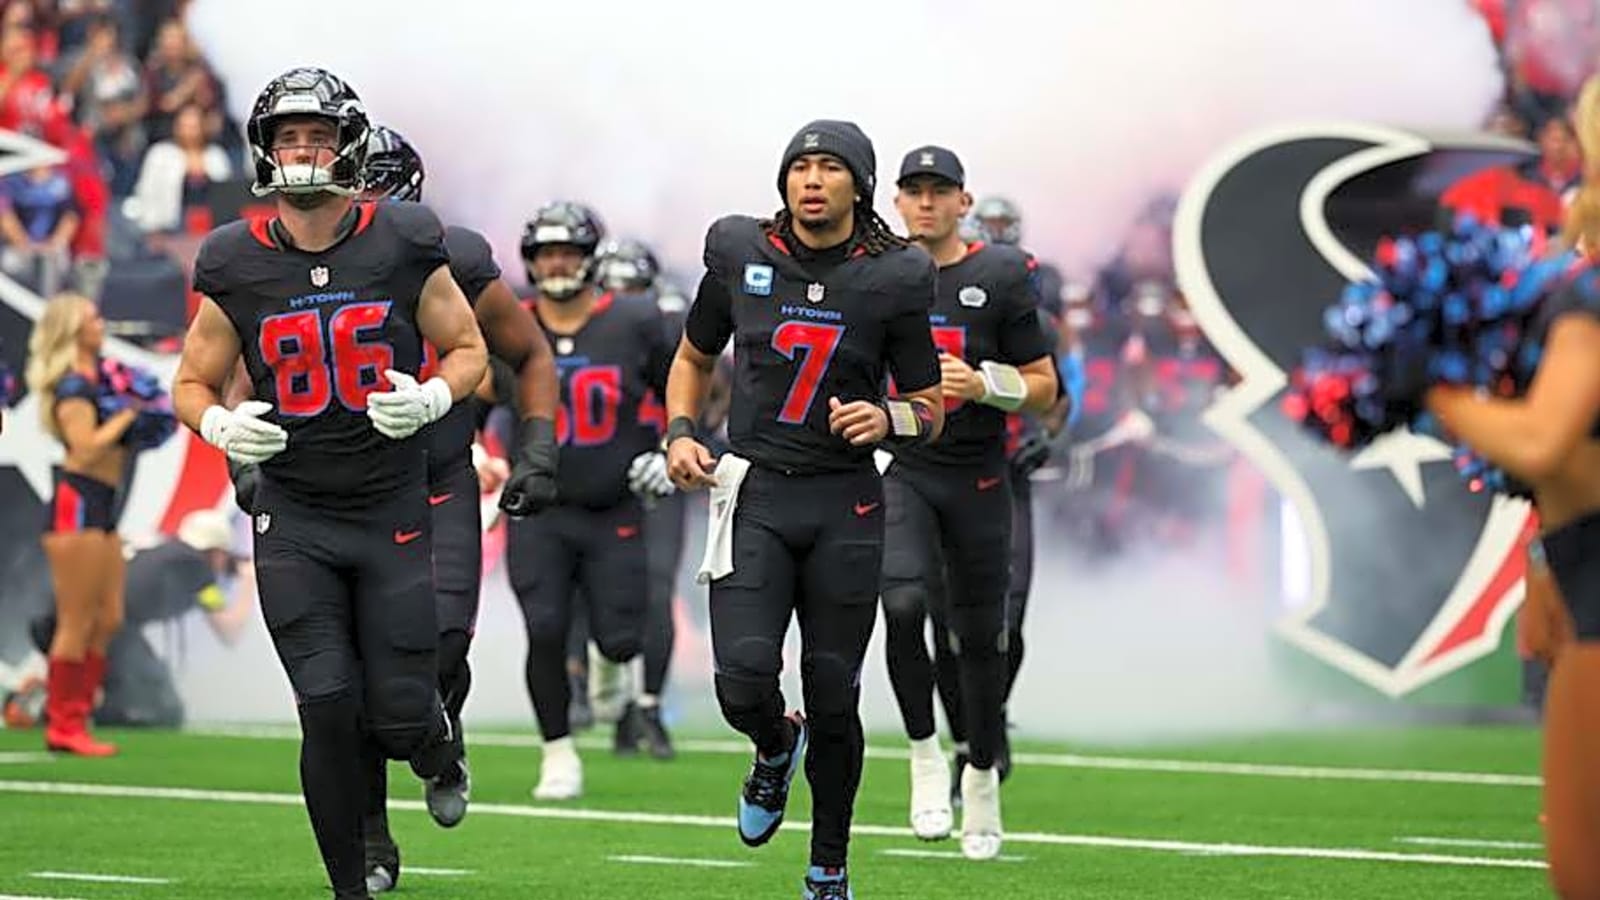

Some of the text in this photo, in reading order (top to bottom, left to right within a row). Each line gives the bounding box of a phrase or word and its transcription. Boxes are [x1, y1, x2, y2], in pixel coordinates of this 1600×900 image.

[289, 291, 355, 308] H-TOWN
[781, 305, 842, 320] H-TOWN
[259, 300, 393, 417] 86
[771, 319, 846, 424] 7
